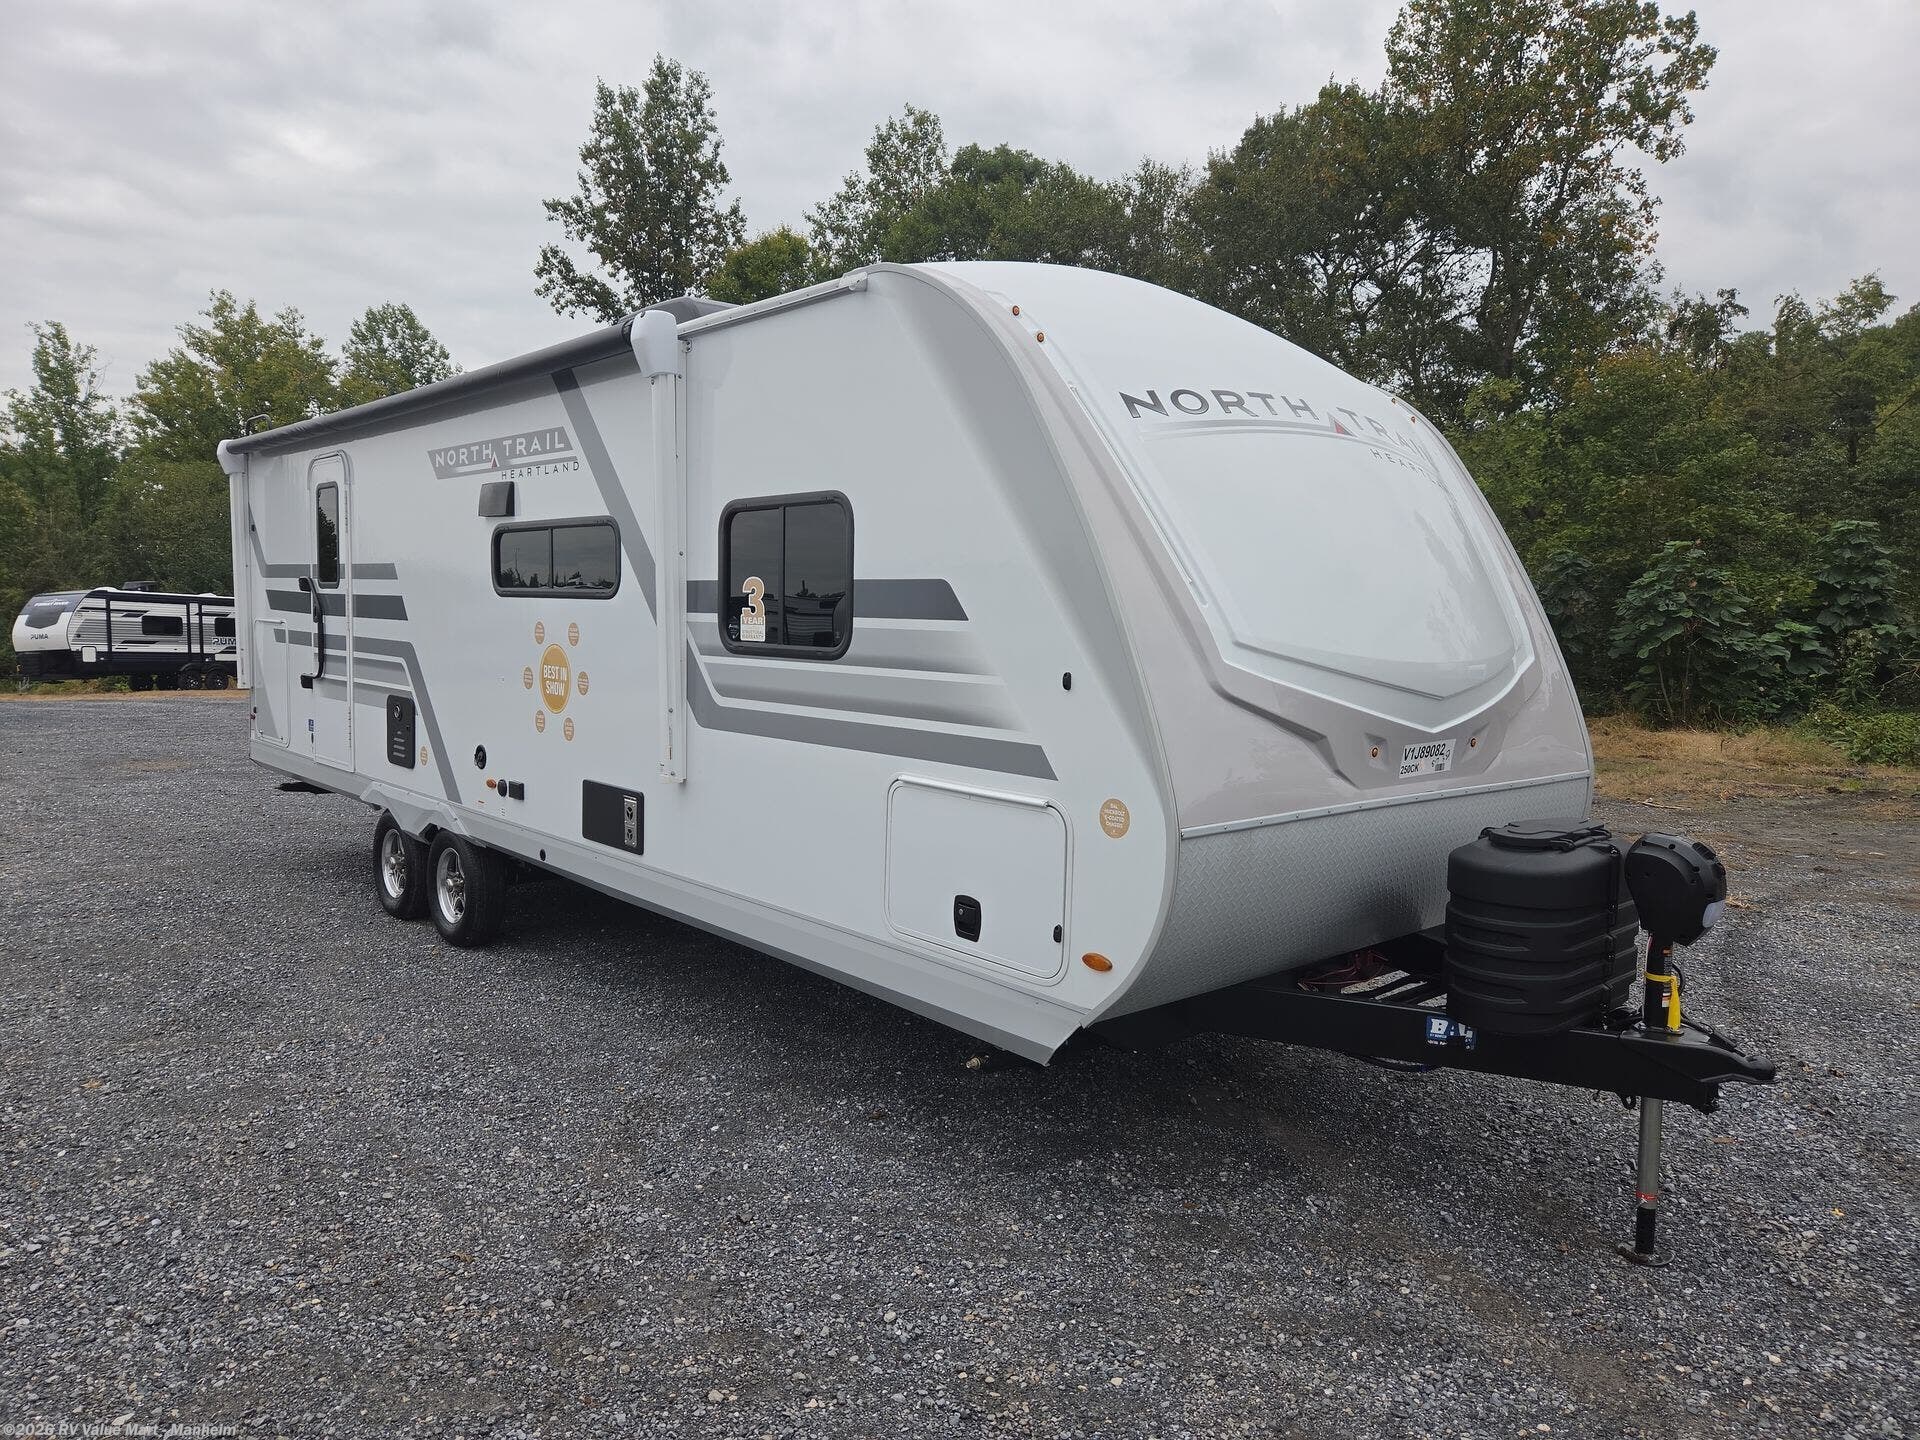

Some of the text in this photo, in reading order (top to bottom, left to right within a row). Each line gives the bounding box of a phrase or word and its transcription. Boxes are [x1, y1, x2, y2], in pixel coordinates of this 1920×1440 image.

[1119, 389, 1320, 420] NORTH
[435, 431, 565, 467] NORTH TRAIL
[501, 461, 580, 480] HEARTLAND
[742, 576, 765, 617] 3
[743, 617, 763, 625] YEAR
[212, 637, 236, 646] PUM
[543, 664, 559, 680] BEST
[559, 666, 568, 681] IN
[545, 681, 565, 697] SHOW
[1404, 743, 1446, 761] V1J89082
